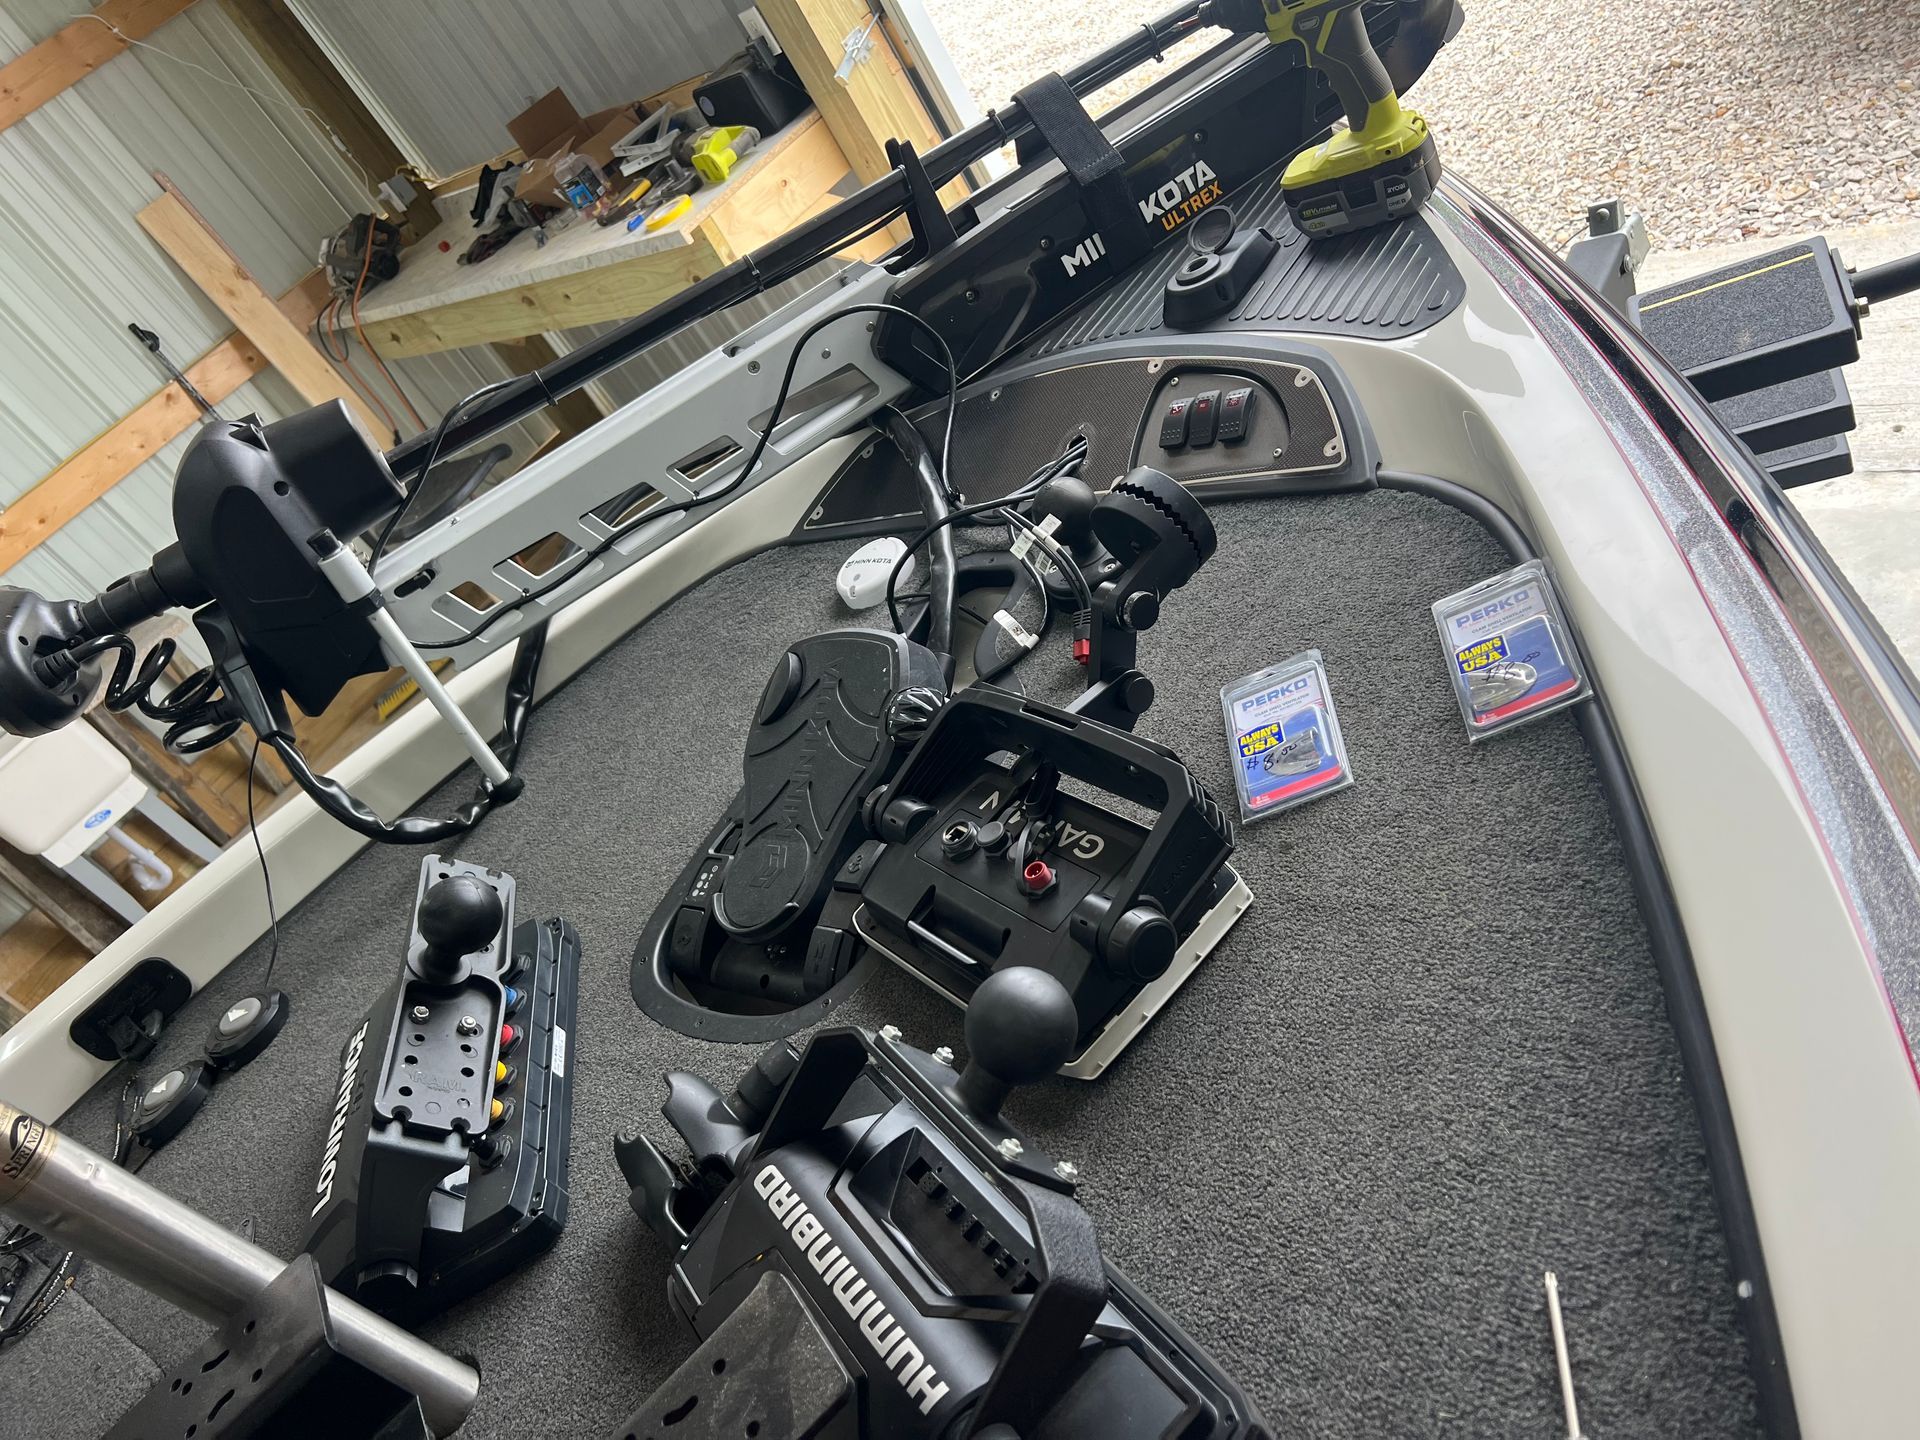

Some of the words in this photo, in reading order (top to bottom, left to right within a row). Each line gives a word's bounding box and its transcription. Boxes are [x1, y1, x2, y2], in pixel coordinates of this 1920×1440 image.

[1138, 160, 1217, 223] KOTA
[1161, 181, 1223, 231] ULTREX
[873, 557, 893, 565] KOTA
[1456, 590, 1530, 628] PERKO
[1458, 638, 1502, 661] ALWAYS
[1463, 652, 1502, 672] USA
[1241, 677, 1308, 712] PERKO
[1239, 723, 1279, 745] ALWAYS
[1243, 738, 1279, 756] USA
[311, 1018, 371, 1220] LOWRANCE
[753, 1164, 950, 1417] HUMMINBIRD
